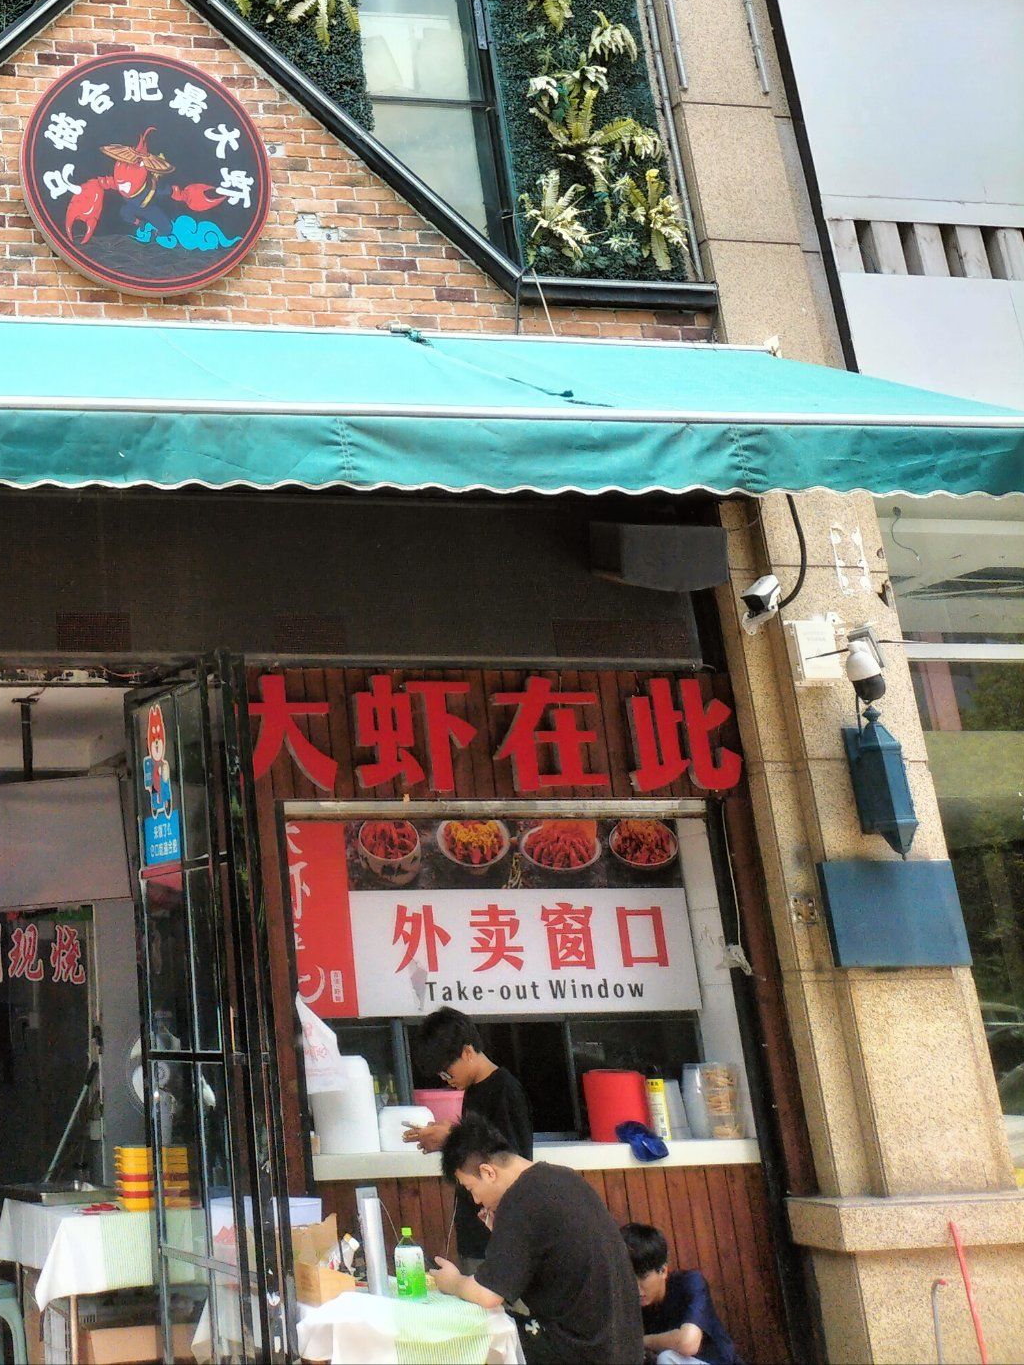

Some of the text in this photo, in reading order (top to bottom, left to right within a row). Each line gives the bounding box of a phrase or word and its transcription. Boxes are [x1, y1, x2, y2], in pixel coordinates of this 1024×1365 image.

[42, 68, 255, 209] 只做合肥最大虾
[239, 674, 743, 793] 大虾在此
[391, 902, 670, 974] 外卖窗口
[425, 979, 646, 1002] Take-out Window
